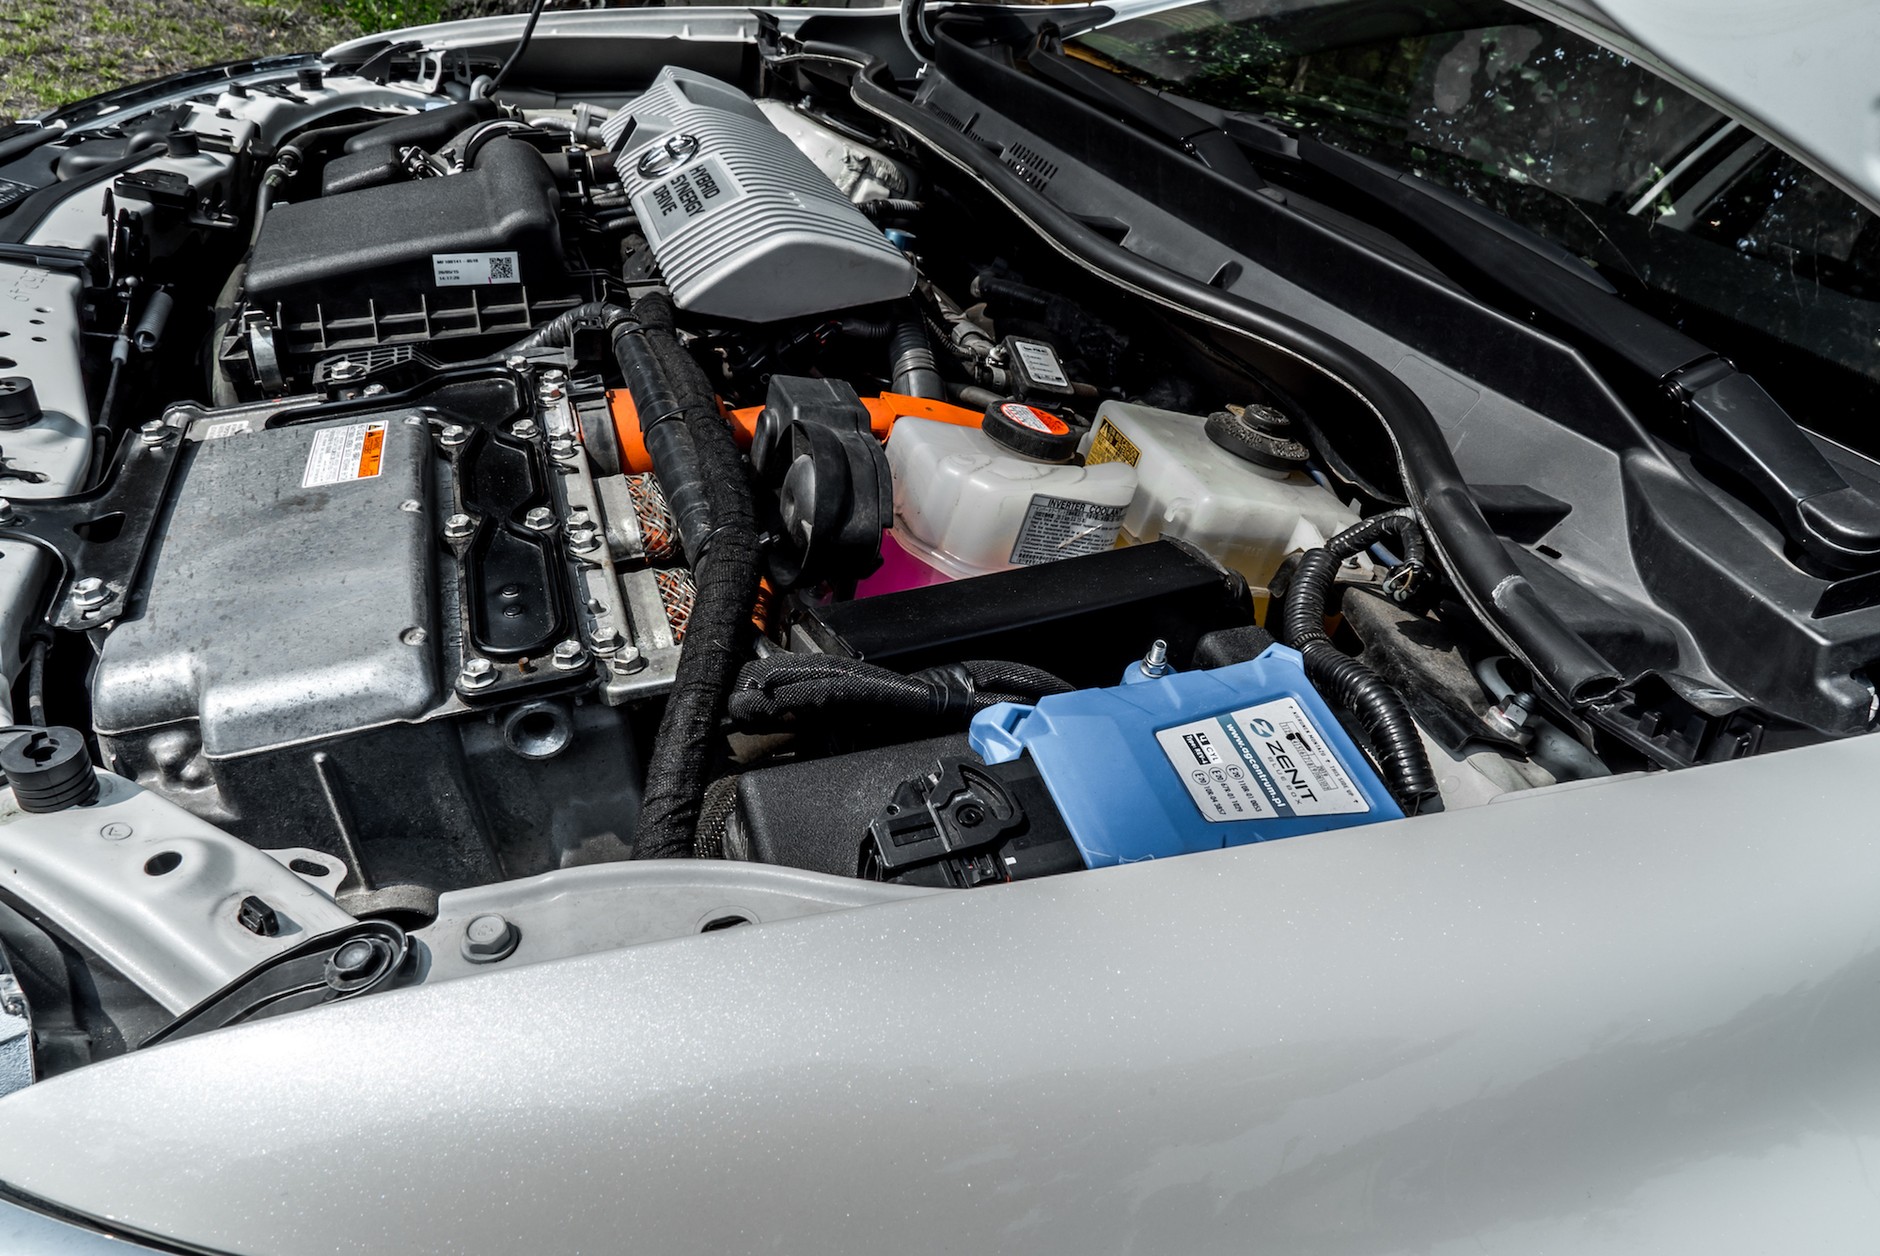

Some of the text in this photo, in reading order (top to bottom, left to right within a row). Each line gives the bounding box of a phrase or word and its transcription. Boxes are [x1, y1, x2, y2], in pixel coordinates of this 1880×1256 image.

[652, 184, 678, 216] DRIVE
[670, 174, 706, 217] SYNERGY
[689, 164, 720, 200] HYBRID
[1048, 498, 1085, 512] INVERTER
[1206, 746, 1218, 761] CYL
[1224, 723, 1287, 807] www.agcentrum.pl
[1265, 740, 1318, 802] ZENIT
[1268, 756, 1301, 804] BLUE BOX
